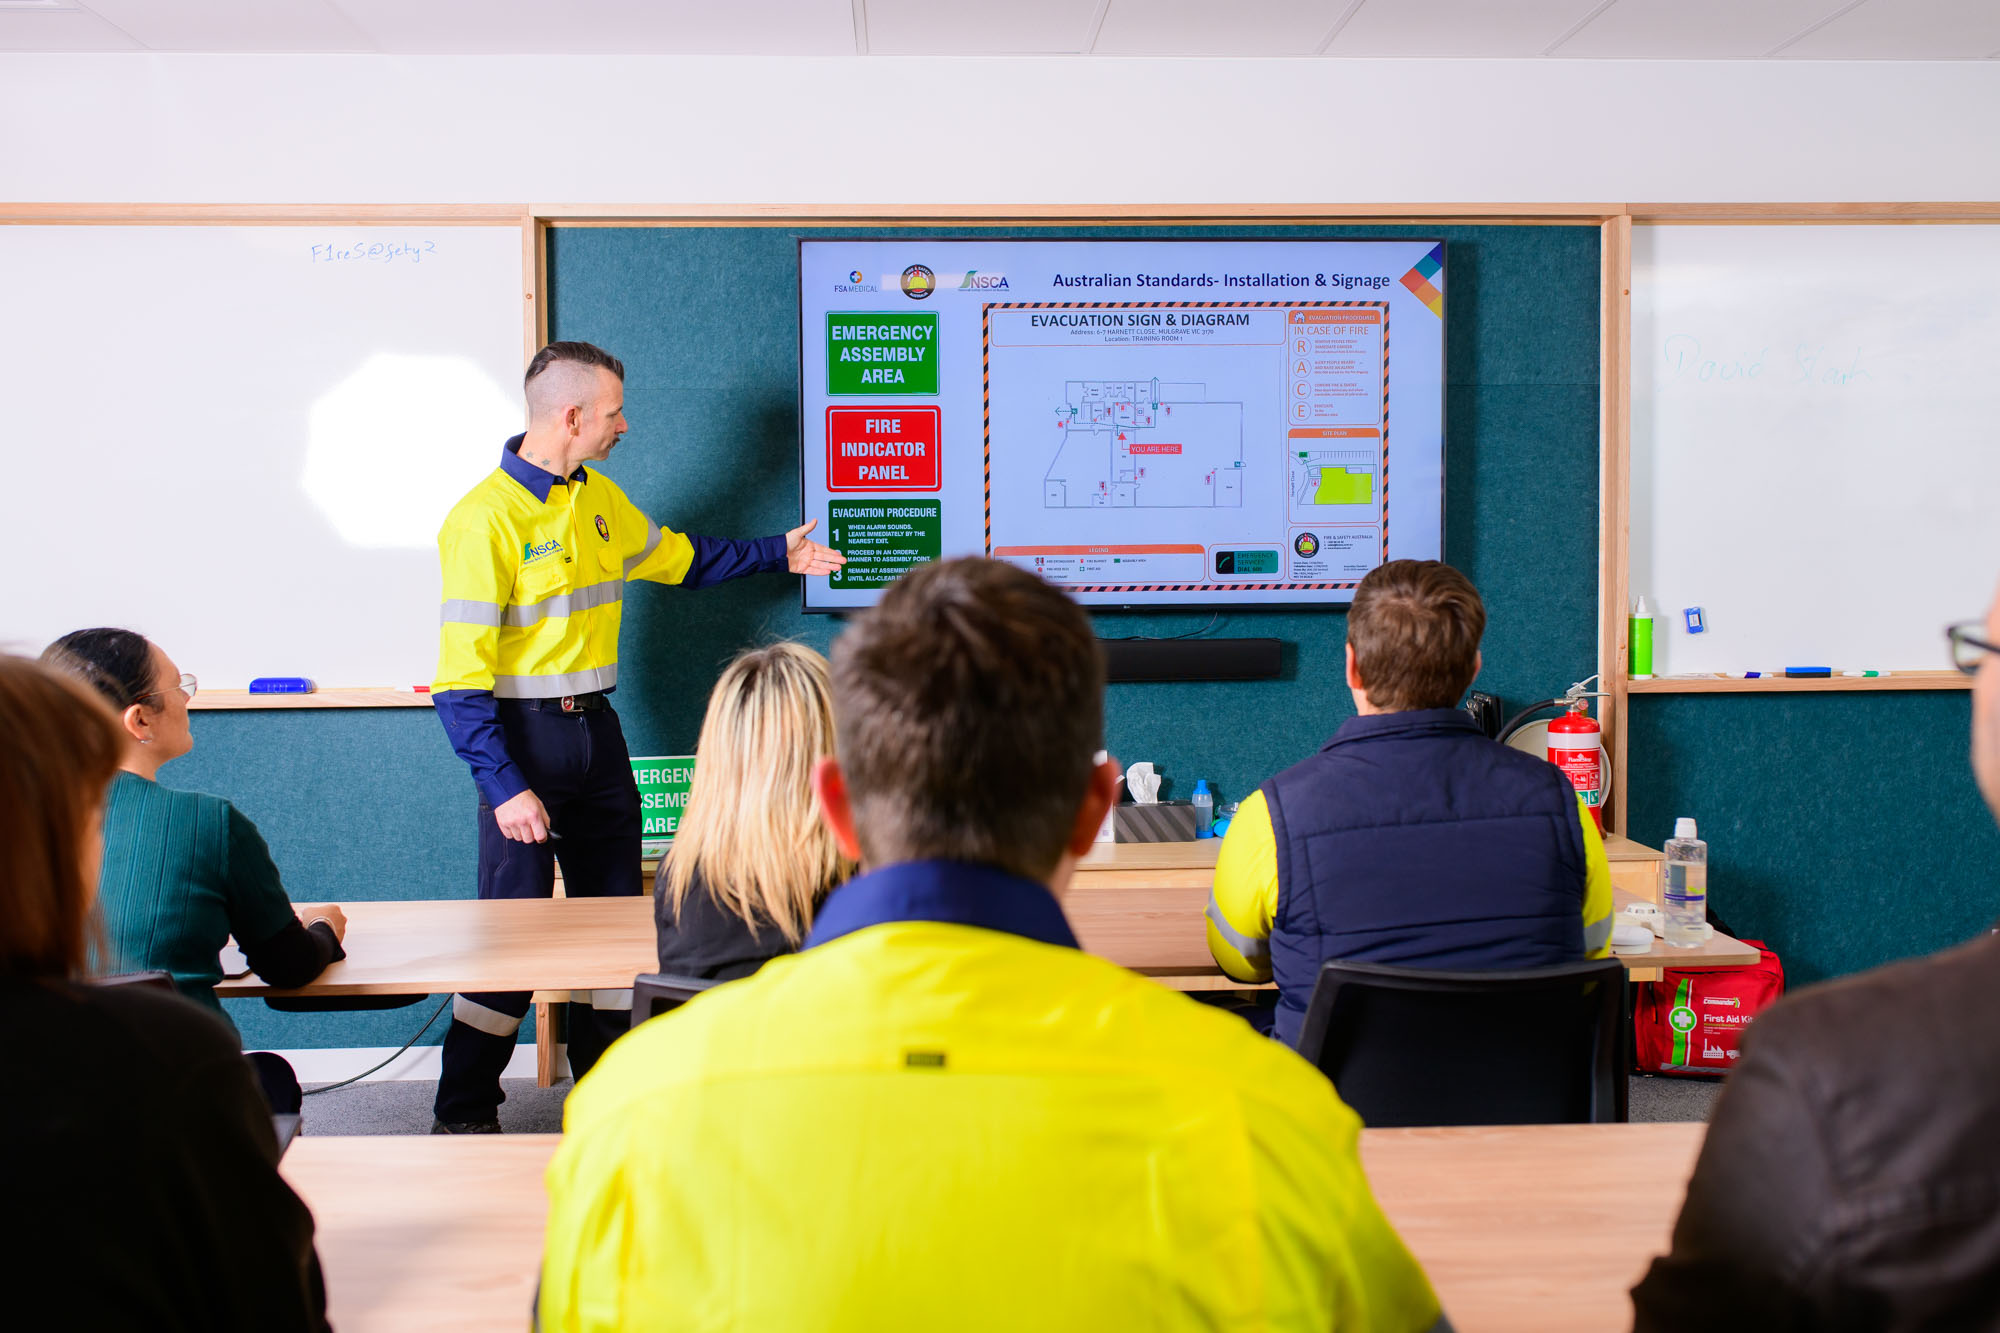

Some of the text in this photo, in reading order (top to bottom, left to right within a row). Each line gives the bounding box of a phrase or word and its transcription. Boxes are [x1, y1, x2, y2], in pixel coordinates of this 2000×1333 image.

[971, 276, 1009, 288] NSCA
[1053, 273, 1391, 290] Australian Standards- Installation & Signage
[834, 285, 878, 293] FSA MEDICAL
[1031, 313, 1250, 327] EVACUATION SIGN & DIAGRAM
[832, 325, 933, 340] EMERGENCY
[1294, 326, 1369, 336] IN CASE OF FIRE
[1297, 340, 1306, 353] R
[840, 347, 925, 362] ASSEMBLY
[1296, 361, 1307, 374] A
[861, 369, 905, 383] AREA
[1297, 383, 1306, 396] C
[1298, 405, 1305, 417] E
[865, 419, 901, 434] FIRE
[841, 442, 925, 457] INDICATOR
[858, 465, 909, 480] PANEL
[832, 507, 937, 518] EVACUATION PROCEDURE
[832, 529, 840, 541] 1
[529, 539, 561, 558] NSCA
[832, 570, 842, 581] 3
[1703, 1014, 1753, 1024] First Aid Kit
